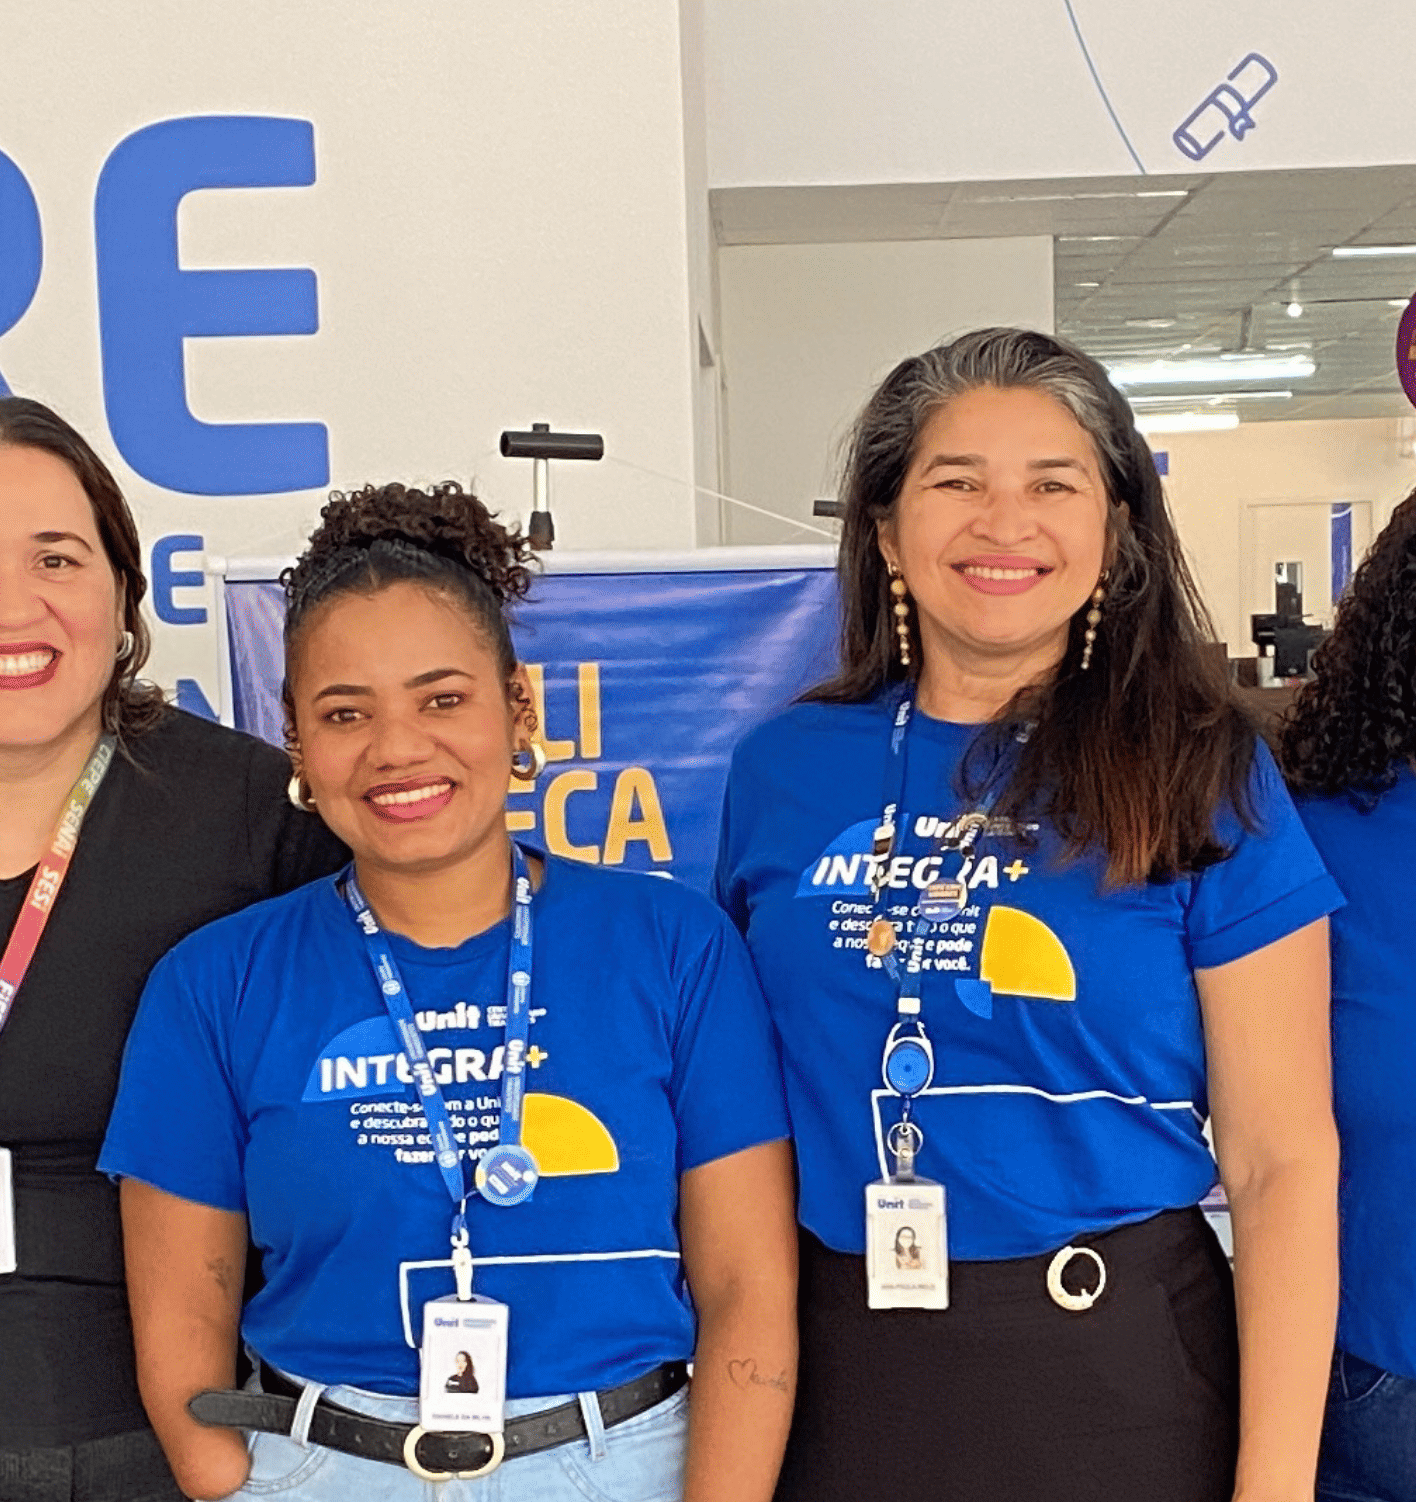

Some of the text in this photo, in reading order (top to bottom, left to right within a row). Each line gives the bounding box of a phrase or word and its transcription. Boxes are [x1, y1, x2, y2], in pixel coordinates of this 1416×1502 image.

[51, 799, 83, 859] SENAI
[812, 853, 1029, 888] INTEGA+
[31, 865, 59, 913] SESI
[951, 922, 977, 935] que
[937, 937, 973, 954] pode
[415, 1002, 480, 1031] Unit
[363, 1117, 428, 1129] descubra
[371, 1133, 414, 1145] nossa
